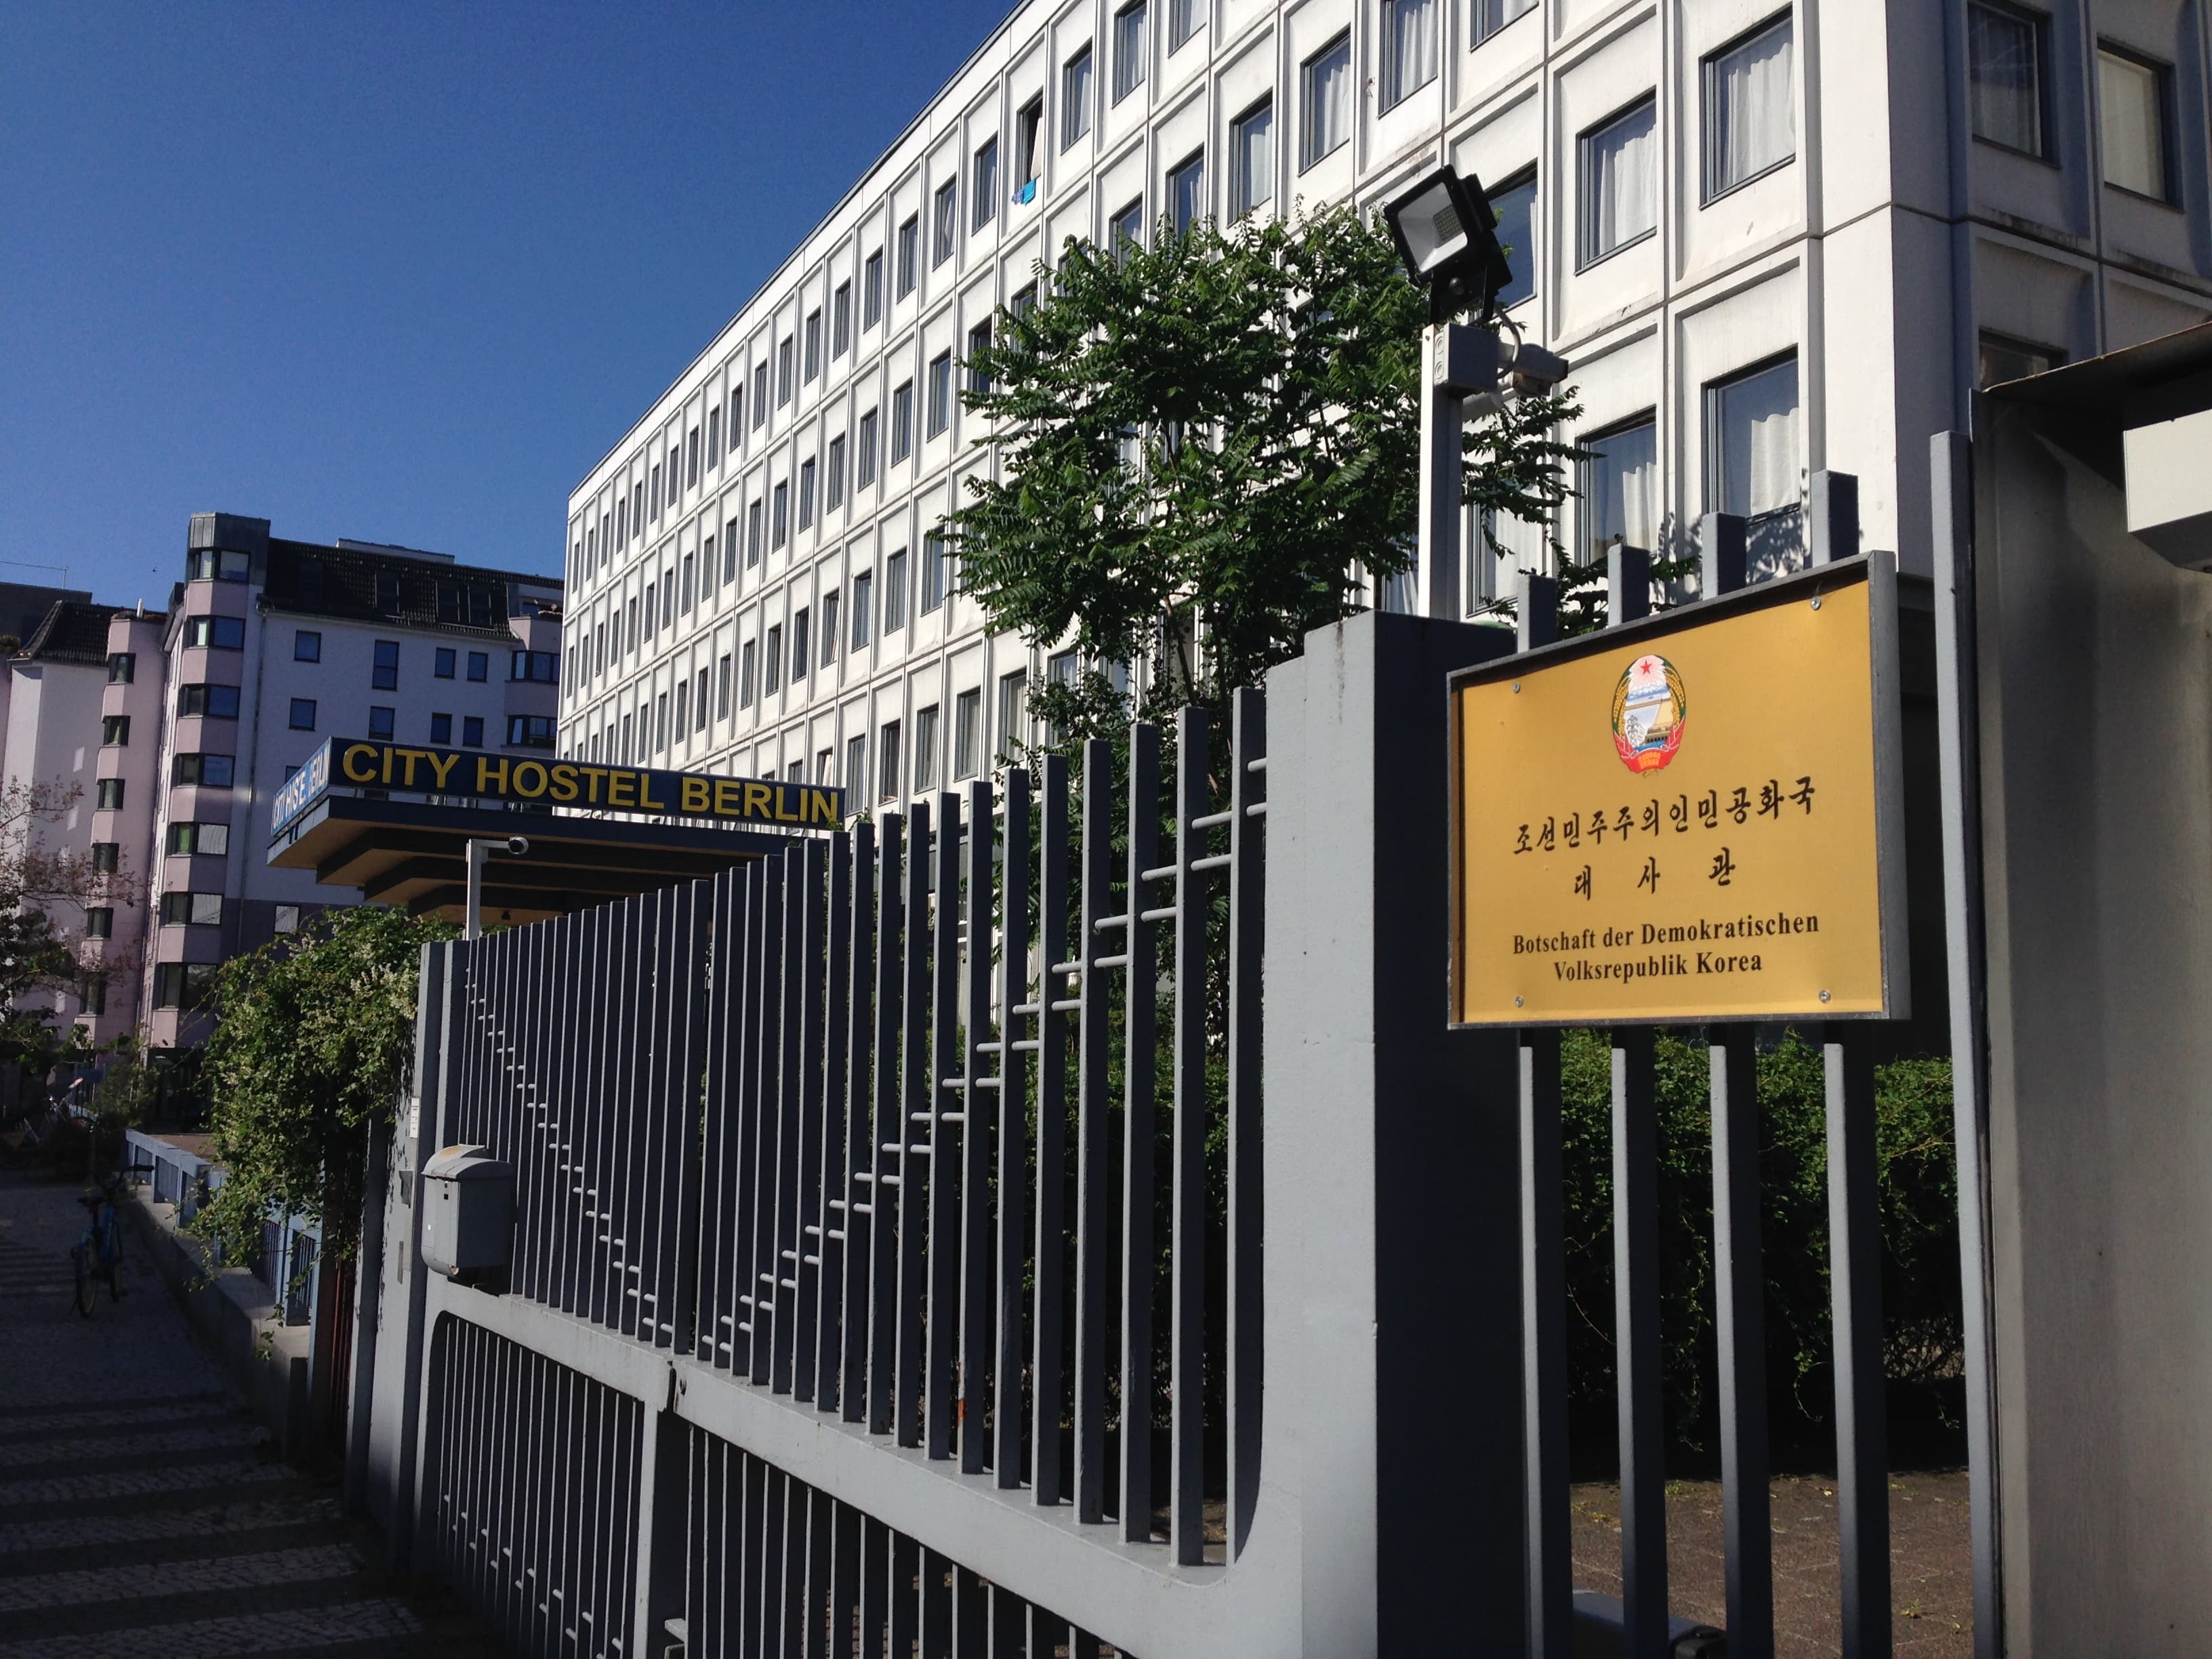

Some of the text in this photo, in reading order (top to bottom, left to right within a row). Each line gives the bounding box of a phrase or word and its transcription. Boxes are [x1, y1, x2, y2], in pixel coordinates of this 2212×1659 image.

[342, 744, 839, 823] CITY HOSTEL BERLIN
[1513, 775, 1815, 855] 조선민주주의인민공화국
[1513, 912, 1820, 955] Botschaft der Demokratischen
[1554, 951, 1763, 984] Volksrepublik Korea
